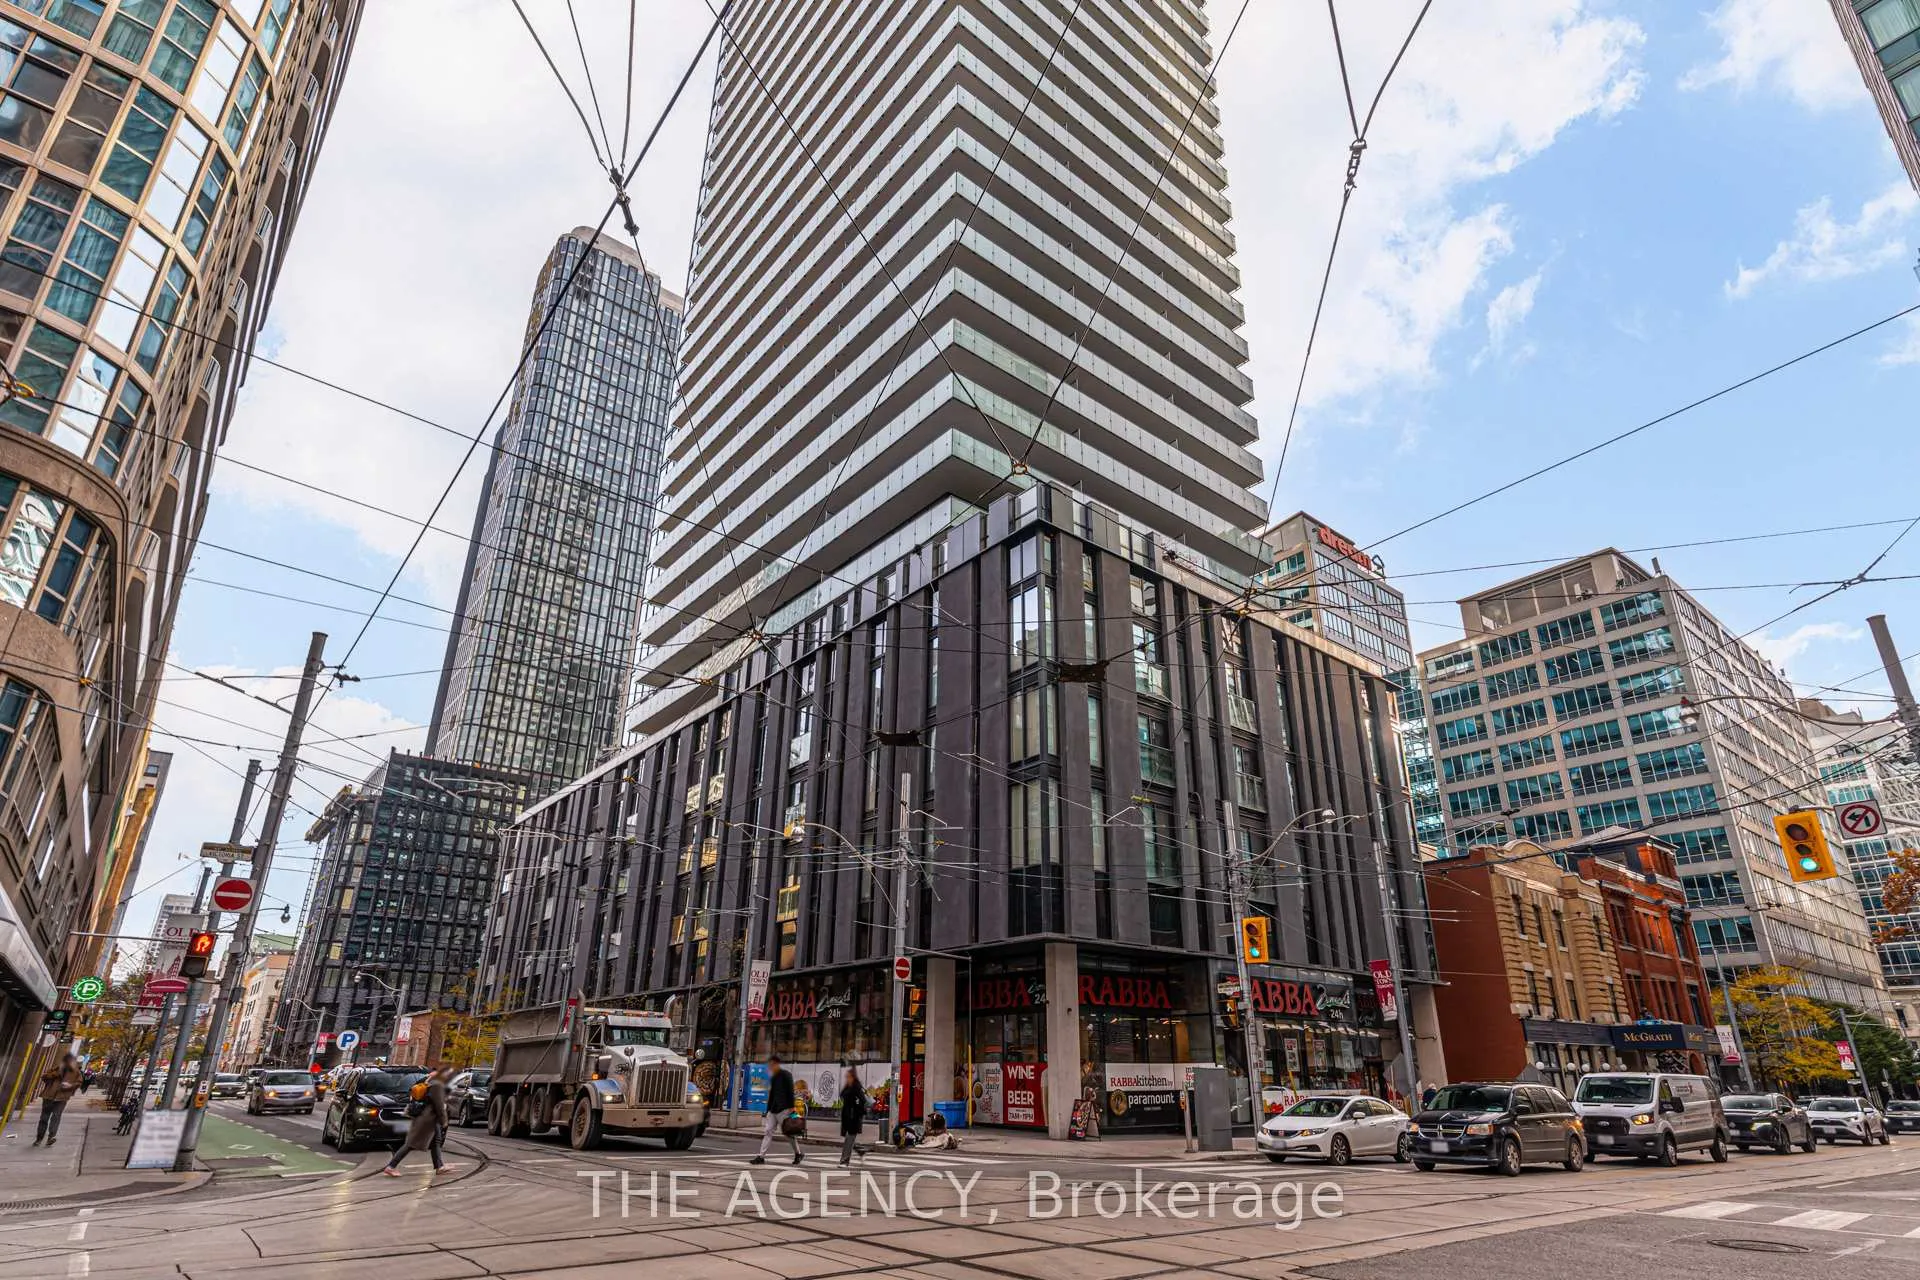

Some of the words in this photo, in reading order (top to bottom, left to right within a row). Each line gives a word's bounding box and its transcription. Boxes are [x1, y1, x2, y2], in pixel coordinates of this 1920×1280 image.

[1318, 526, 1372, 571] dream
[751, 970, 769, 979] OLD
[1373, 970, 1392, 979] OLD
[1078, 975, 1172, 1009] RABBA
[1238, 978, 1319, 1016] ABBA
[763, 989, 819, 1020] ABBA
[829, 1007, 841, 1018] 24h
[1330, 1008, 1344, 1020] 24h
[1007, 1065, 1035, 1080] WINE
[1007, 1090, 1034, 1106] BEER
[1128, 1093, 1176, 1108] paramount
